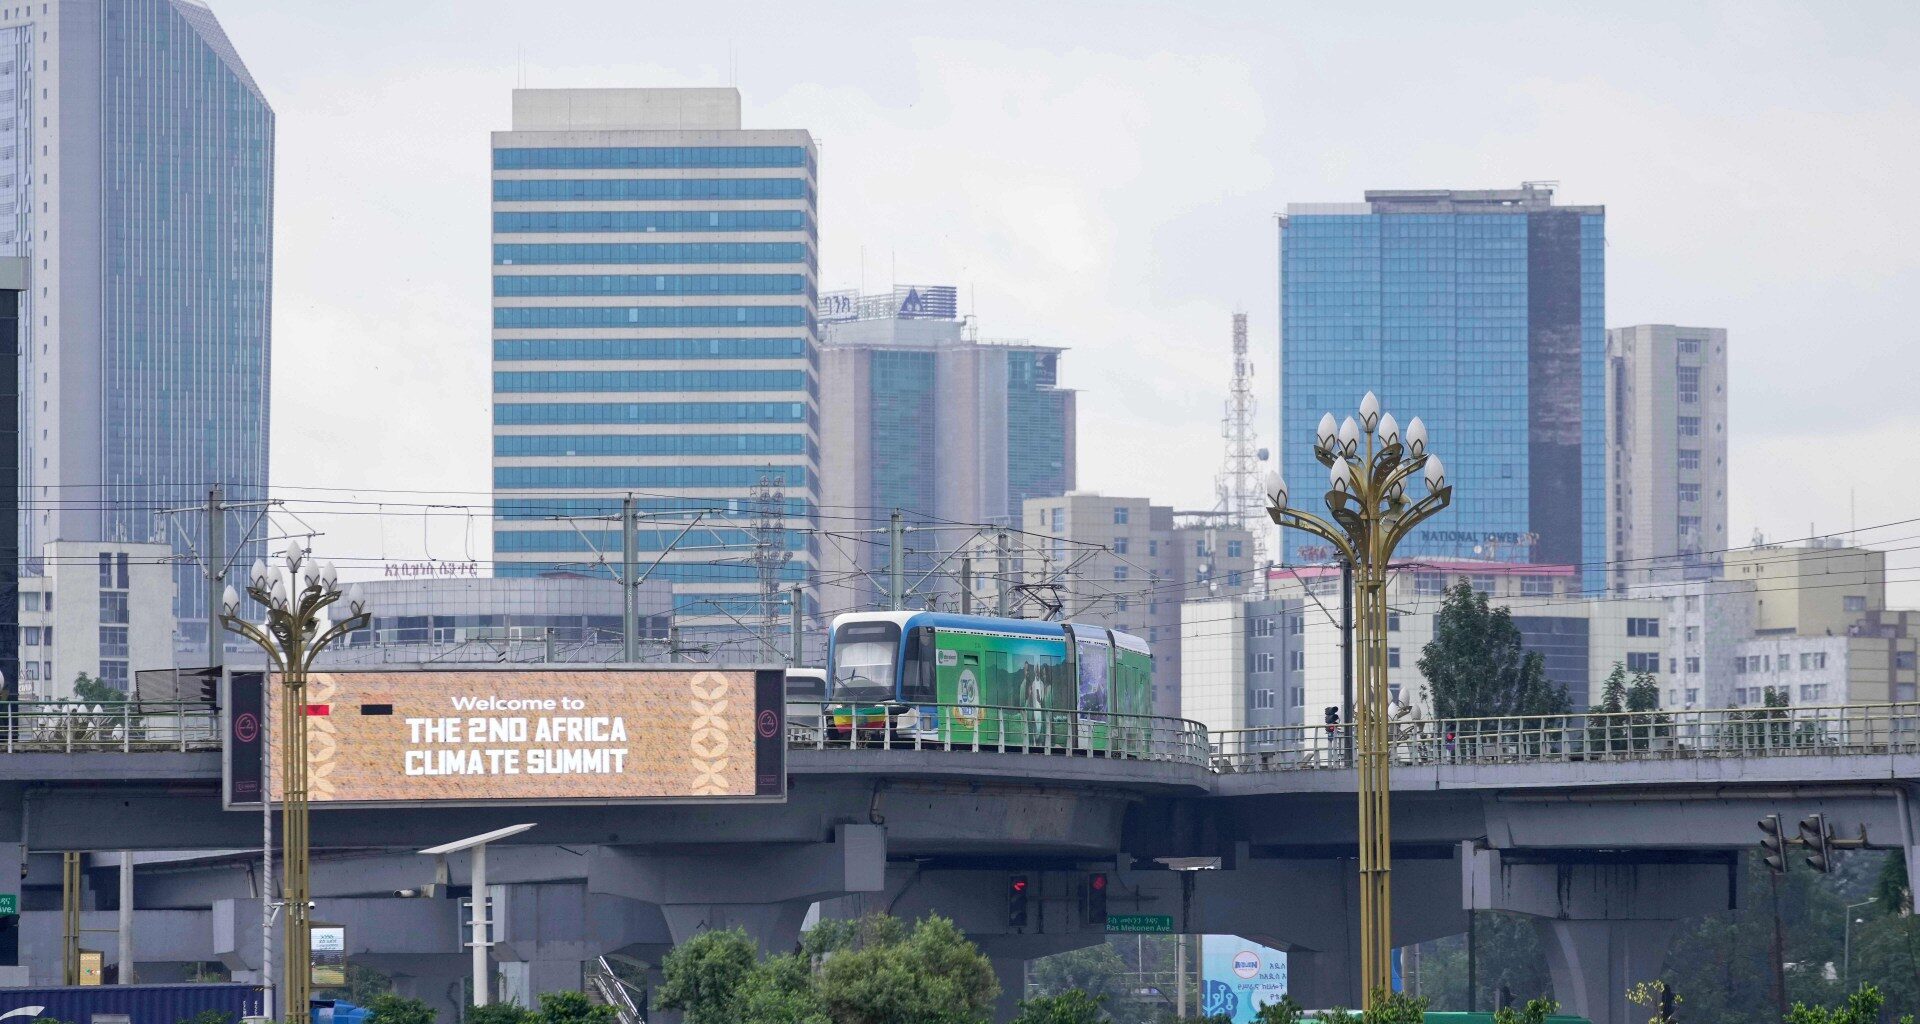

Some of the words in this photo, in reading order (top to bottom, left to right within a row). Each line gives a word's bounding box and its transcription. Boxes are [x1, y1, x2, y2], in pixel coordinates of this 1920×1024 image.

[1421, 531, 1479, 541] NATIONAL
[1482, 532, 1518, 542] TOWER
[451, 696, 557, 711] Welcome
[561, 697, 585, 711] to
[405, 718, 461, 743] THE
[468, 717, 527, 742] 2ND
[534, 716, 627, 742] AFRICA
[405, 749, 519, 775] CLIMATE
[526, 748, 628, 774] SUMMIT
